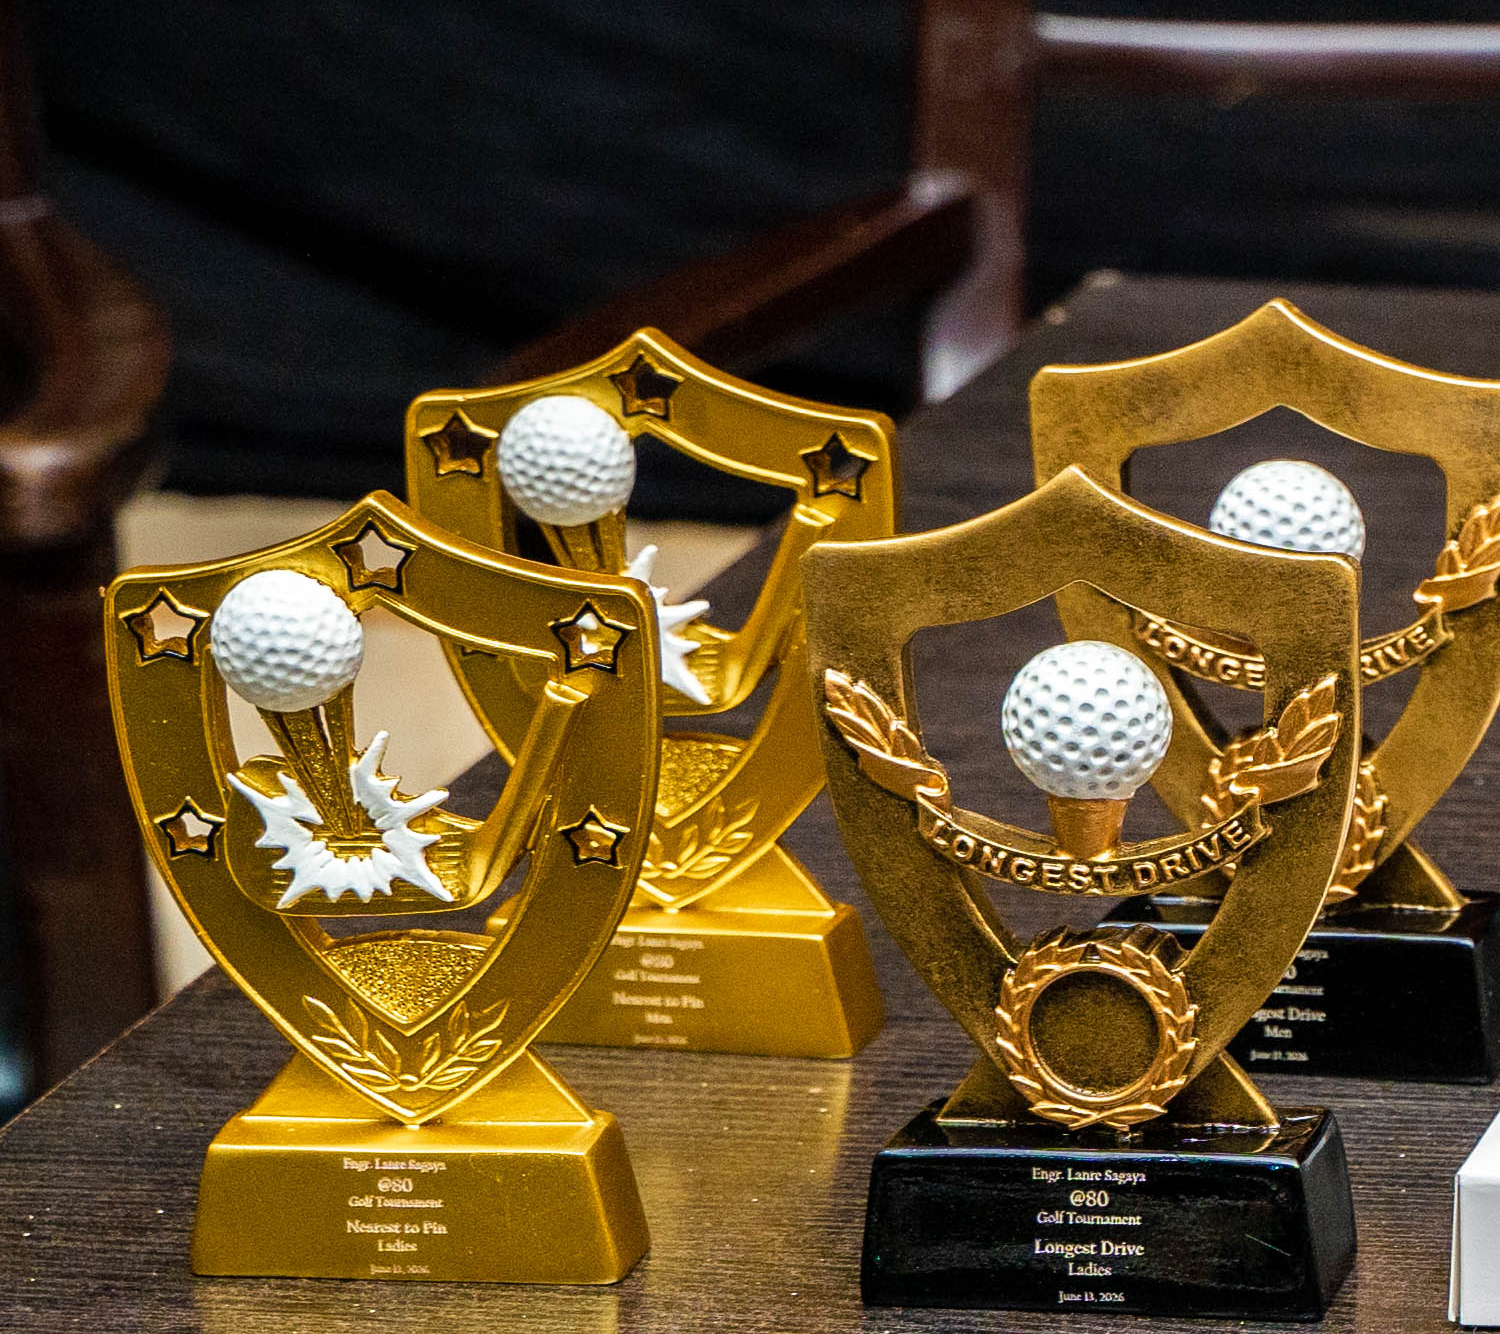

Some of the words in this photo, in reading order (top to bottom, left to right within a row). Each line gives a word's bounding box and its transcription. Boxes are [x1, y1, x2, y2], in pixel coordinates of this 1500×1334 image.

[1145, 621, 1267, 686] LONGE
[1360, 625, 1436, 678] RIVE
[930, 819, 1119, 893] LONGEST
[1133, 819, 1253, 887] DRIVE
[1032, 1166, 1065, 1183] Engr.
[1067, 1167, 1102, 1181] Lanre
[1104, 1169, 1147, 1185] Sagaya
[377, 1177, 414, 1192] @80
[348, 1195, 375, 1207] Golf
[1069, 1189, 1110, 1207] @80
[1036, 1210, 1065, 1224] Golf
[1065, 1211, 1142, 1226] Tournament
[346, 1219, 402, 1234] Nearest
[404, 1222, 421, 1234] to
[422, 1220, 448, 1234] Pin
[377, 1239, 418, 1252] Ladies
[1034, 1238, 1098, 1259] Longest
[1100, 1240, 1145, 1256] Drive
[1068, 1262, 1112, 1276] Ladies
[1058, 1290, 1082, 1303] June
[1083, 1291, 1098, 1303] 13,
[1099, 1292, 1125, 1302] 2026
